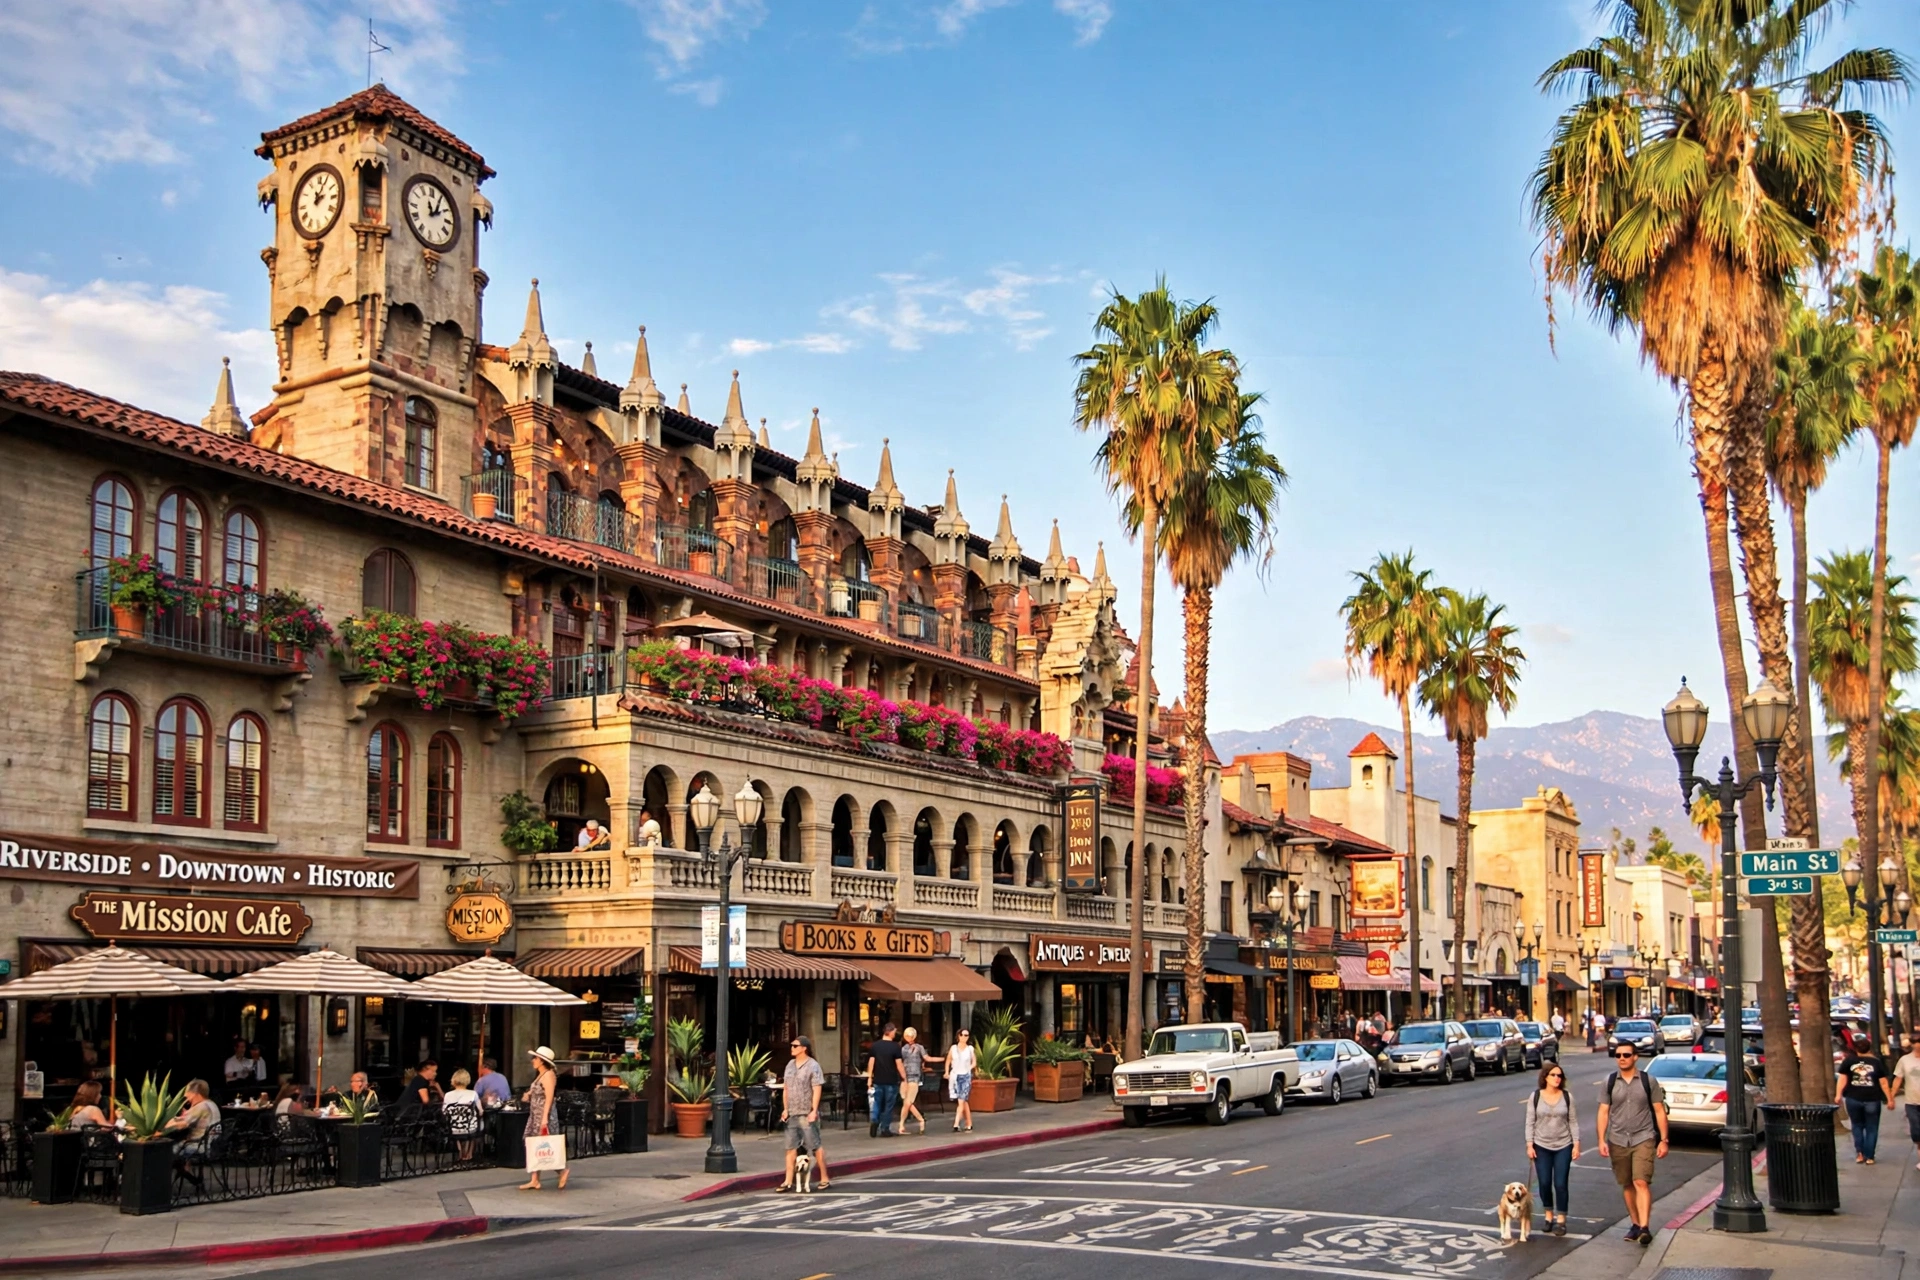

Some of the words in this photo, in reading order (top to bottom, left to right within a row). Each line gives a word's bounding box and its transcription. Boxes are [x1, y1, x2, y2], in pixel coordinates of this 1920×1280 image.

[0, 840, 132, 876] RIVERSIDE
[158, 853, 286, 884] DOWNTOWN
[308, 864, 396, 889] HISTORIC
[1753, 854, 1797, 872] Main
[1808, 853, 1828, 870] St
[1767, 879, 1787, 892] 3rd
[1791, 880, 1803, 890] St
[92, 901, 117, 914] THE
[452, 908, 502, 925] MISSION
[802, 924, 856, 950] BOOKS
[864, 930, 877, 951] &
[886, 930, 929, 953] GIFTS
[1036, 939, 1085, 966] ANTIQUES
[1098, 943, 1131, 965] JEWELR
